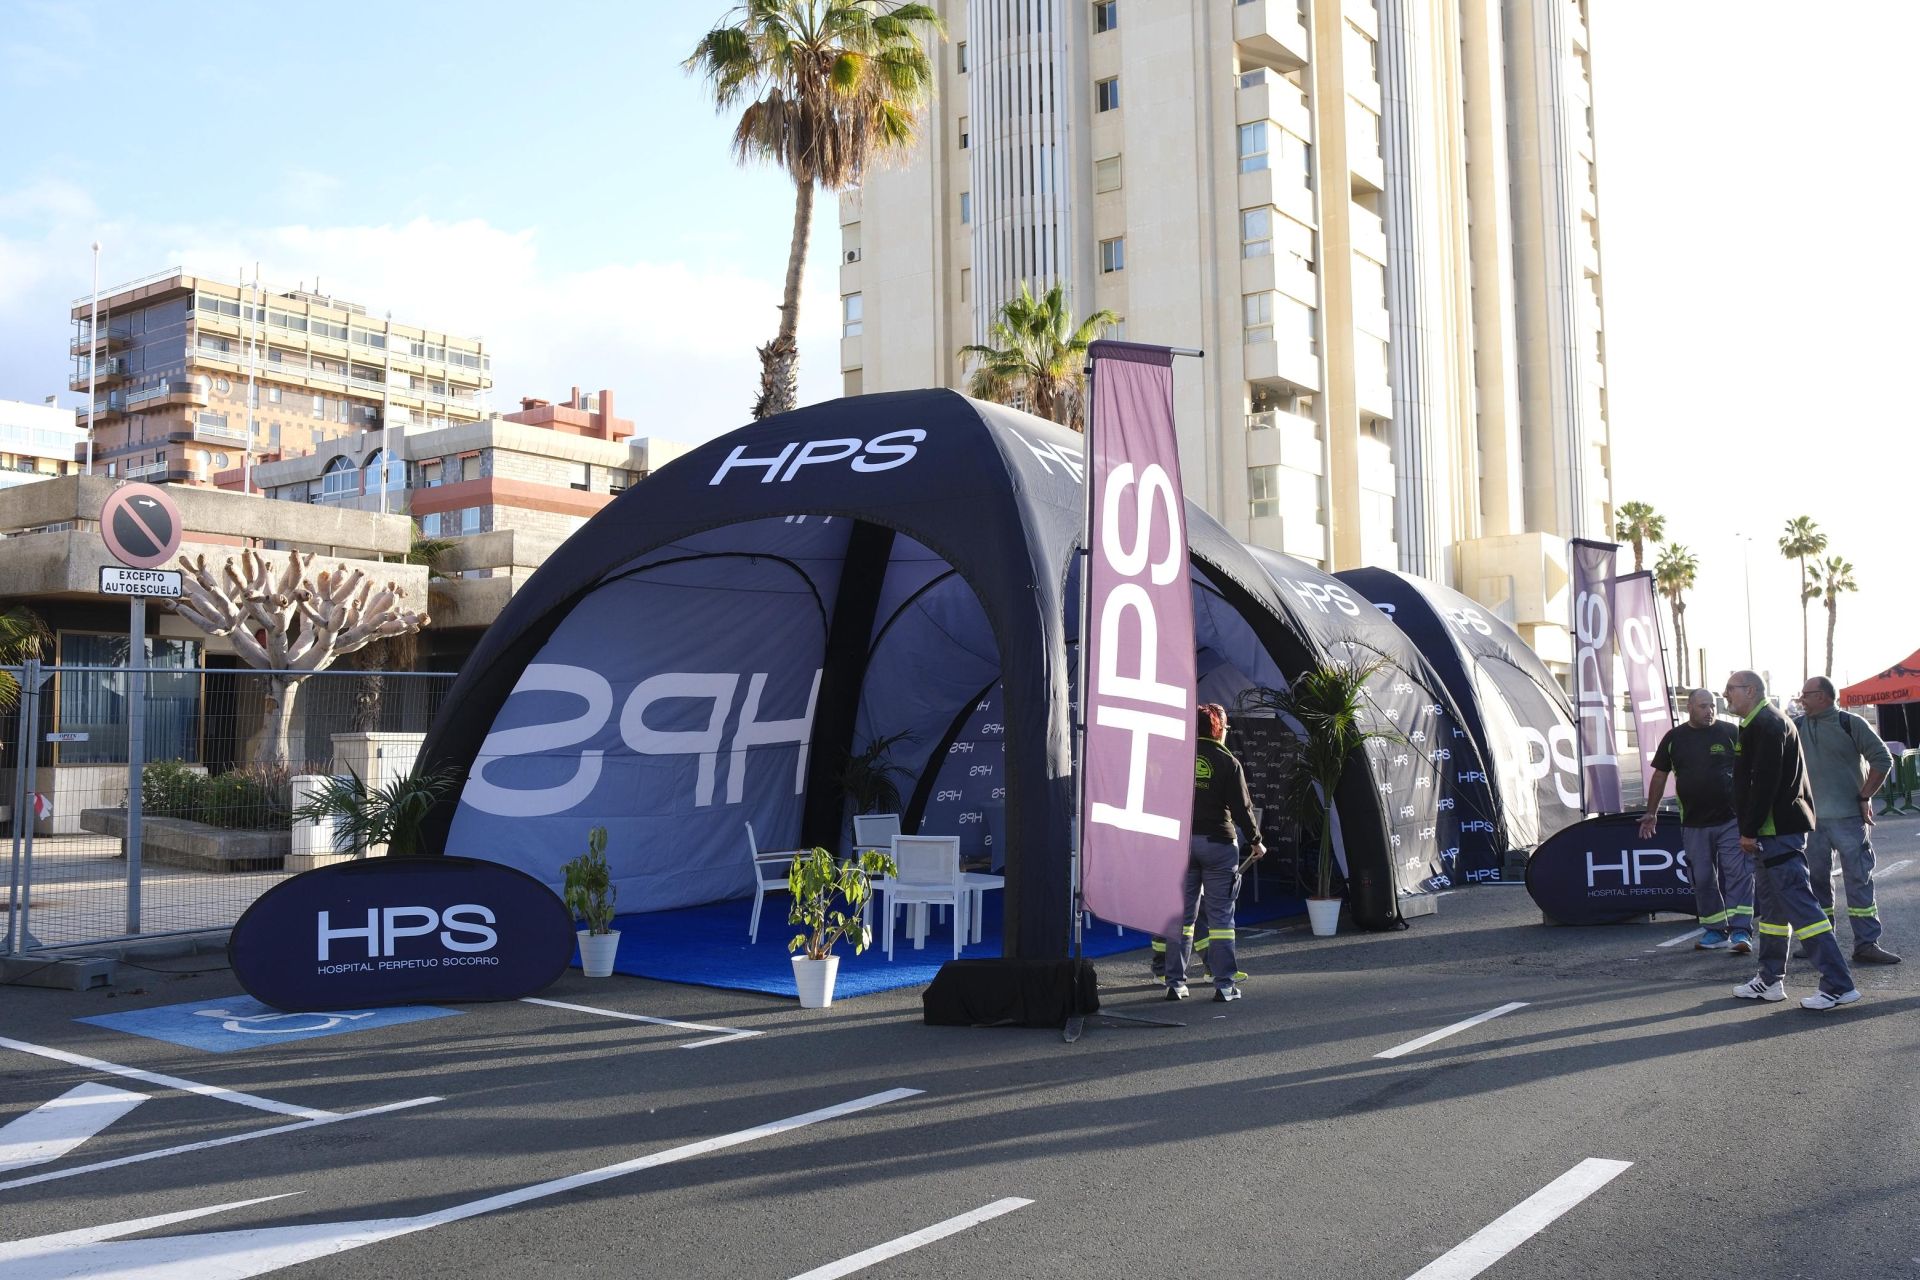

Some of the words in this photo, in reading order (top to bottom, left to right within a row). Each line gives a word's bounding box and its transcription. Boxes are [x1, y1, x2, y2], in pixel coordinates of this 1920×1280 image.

[708, 428, 927, 485] HPS
[1007, 427, 1084, 484] HP
[119, 570, 164, 582] EXCEPTO
[105, 582, 179, 596] AUTOESCUELA
[1282, 576, 1361, 617] HPS
[1090, 462, 1188, 841] HPS
[1575, 590, 1618, 766] HPS
[1394, 683, 1414, 695] HPS
[1422, 703, 1443, 717] HPS
[1371, 737, 1387, 748] HPS
[1410, 731, 1426, 743] HPS
[1393, 754, 1409, 767] HPS
[1428, 748, 1451, 761] HPS
[1415, 776, 1431, 790] HPS
[1458, 771, 1487, 783] HPS
[1379, 782, 1393, 796] HPS
[1400, 804, 1415, 819] HPS
[1436, 798, 1455, 812] HPS
[1419, 826, 1436, 841] HPS
[1461, 821, 1494, 832] HPS
[1391, 834, 1401, 846] PS
[1440, 847, 1459, 861] HP
[1405, 856, 1421, 870] HPS
[1466, 868, 1500, 882] HPS
[1429, 875, 1451, 890] HPS
[1587, 888, 1628, 897] HOSPITAL
[1630, 887, 1674, 896] PERPETUO
[318, 904, 498, 961] HPS
[318, 962, 374, 975] HOSPITAL
[379, 958, 438, 970] PERPETUO
[442, 956, 499, 967] SOCORRO
